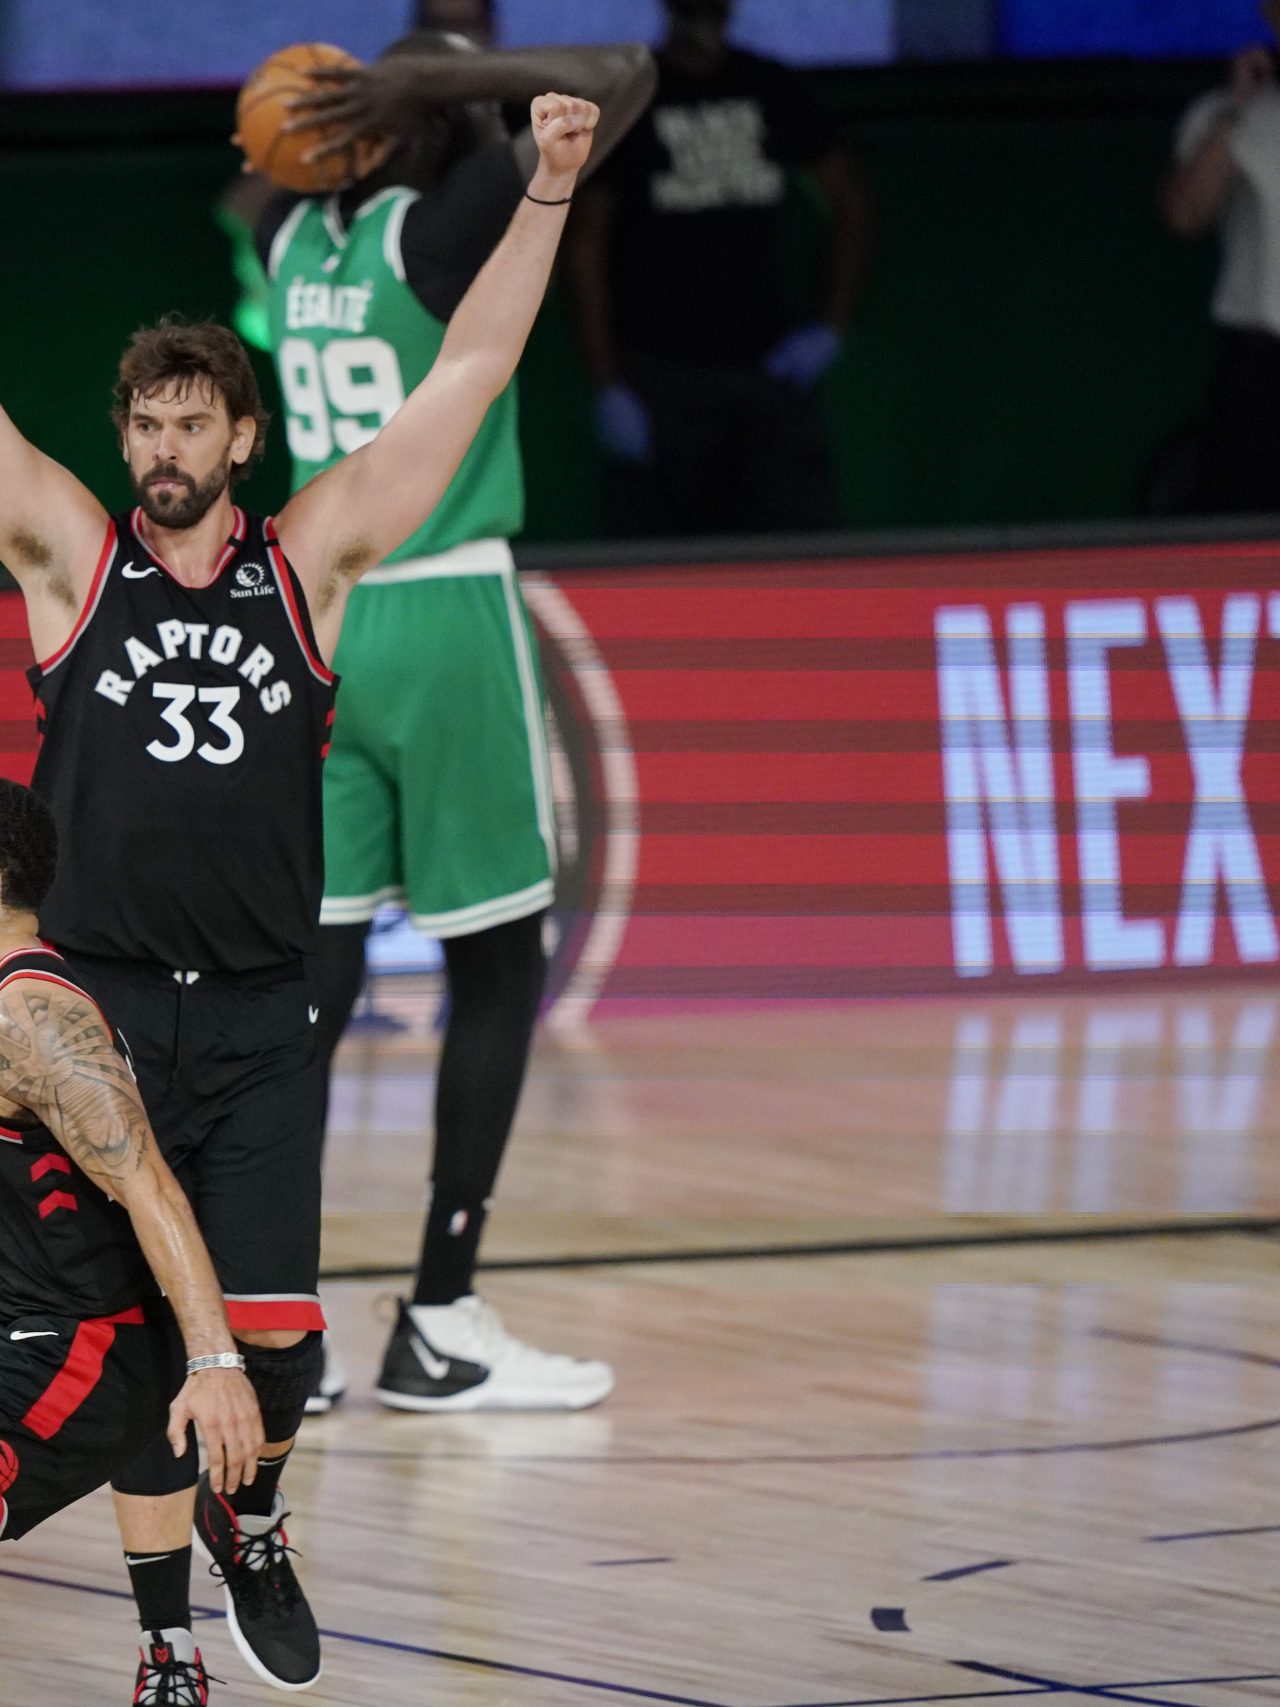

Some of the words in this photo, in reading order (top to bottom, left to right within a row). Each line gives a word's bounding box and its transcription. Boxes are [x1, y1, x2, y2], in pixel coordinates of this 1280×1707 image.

[280, 335, 406, 462] 99
[229, 588, 253, 599] Sun
[253, 584, 276, 596] Life
[94, 618, 292, 715] RAPTORS
[145, 682, 245, 765] 33
